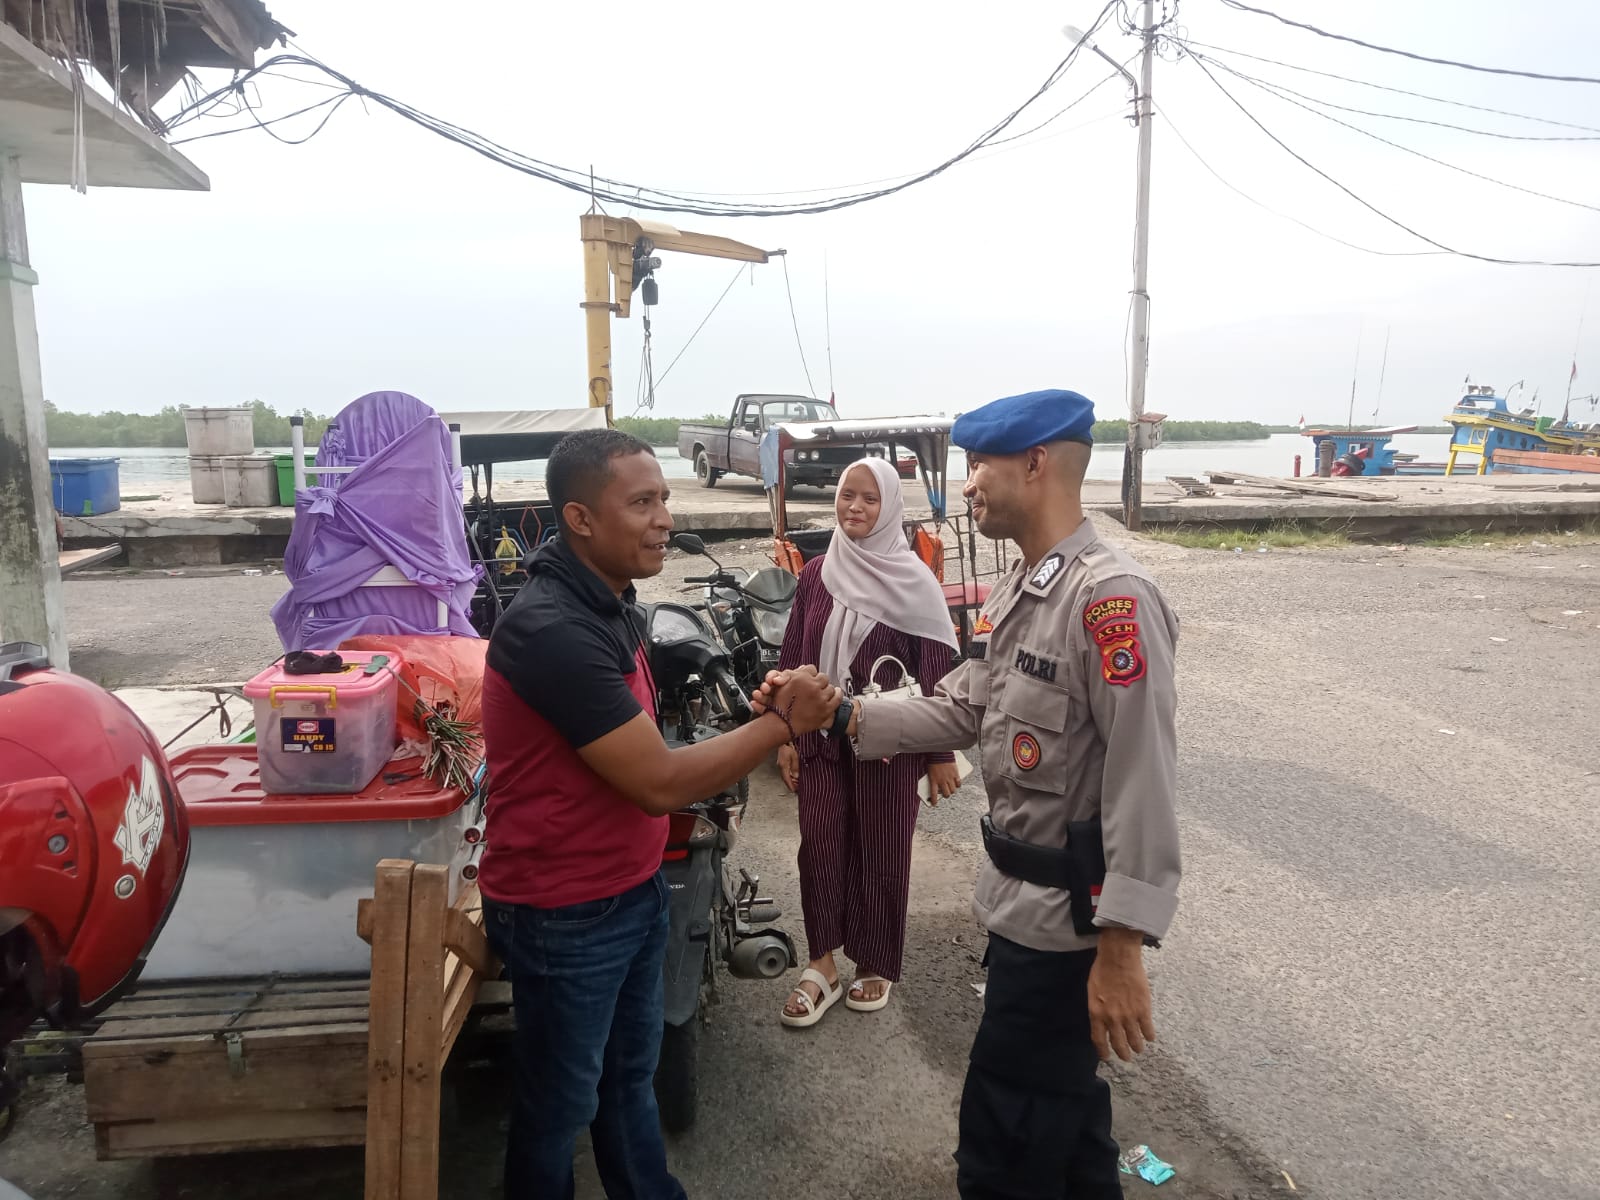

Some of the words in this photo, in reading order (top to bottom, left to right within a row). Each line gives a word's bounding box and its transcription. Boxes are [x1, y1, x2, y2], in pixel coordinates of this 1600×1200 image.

[1085, 600, 1133, 623] POLRES
[1091, 608, 1128, 624] LANGSA
[1097, 624, 1134, 640] ACEH
[1015, 648, 1058, 682] POLRI
